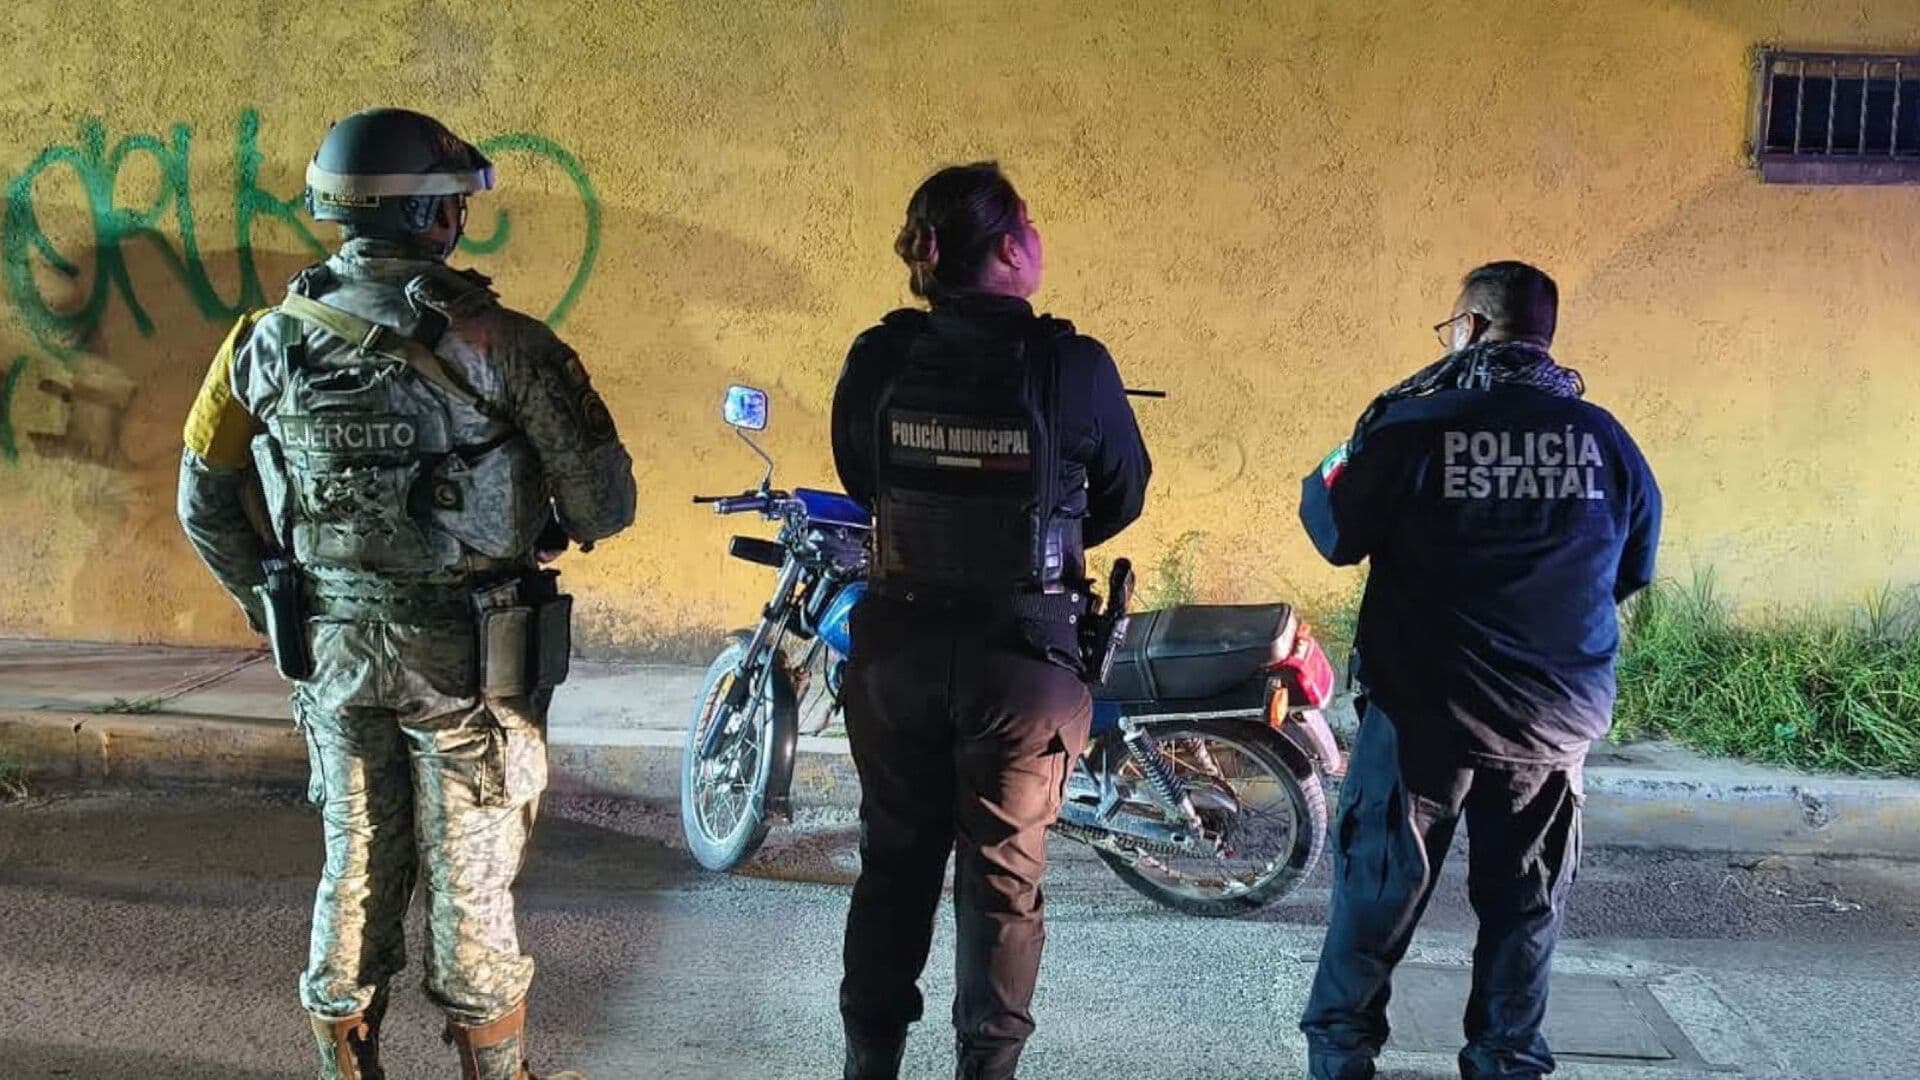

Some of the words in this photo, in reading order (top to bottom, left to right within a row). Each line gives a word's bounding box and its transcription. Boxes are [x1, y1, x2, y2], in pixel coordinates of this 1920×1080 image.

[284, 417, 415, 448] EJÉRCITO
[892, 418, 945, 450] POLICÍA
[948, 427, 1030, 454] MUNICIPAL
[1444, 424, 1603, 467] POLICÍA
[1444, 465, 1604, 499] ESTATAL
